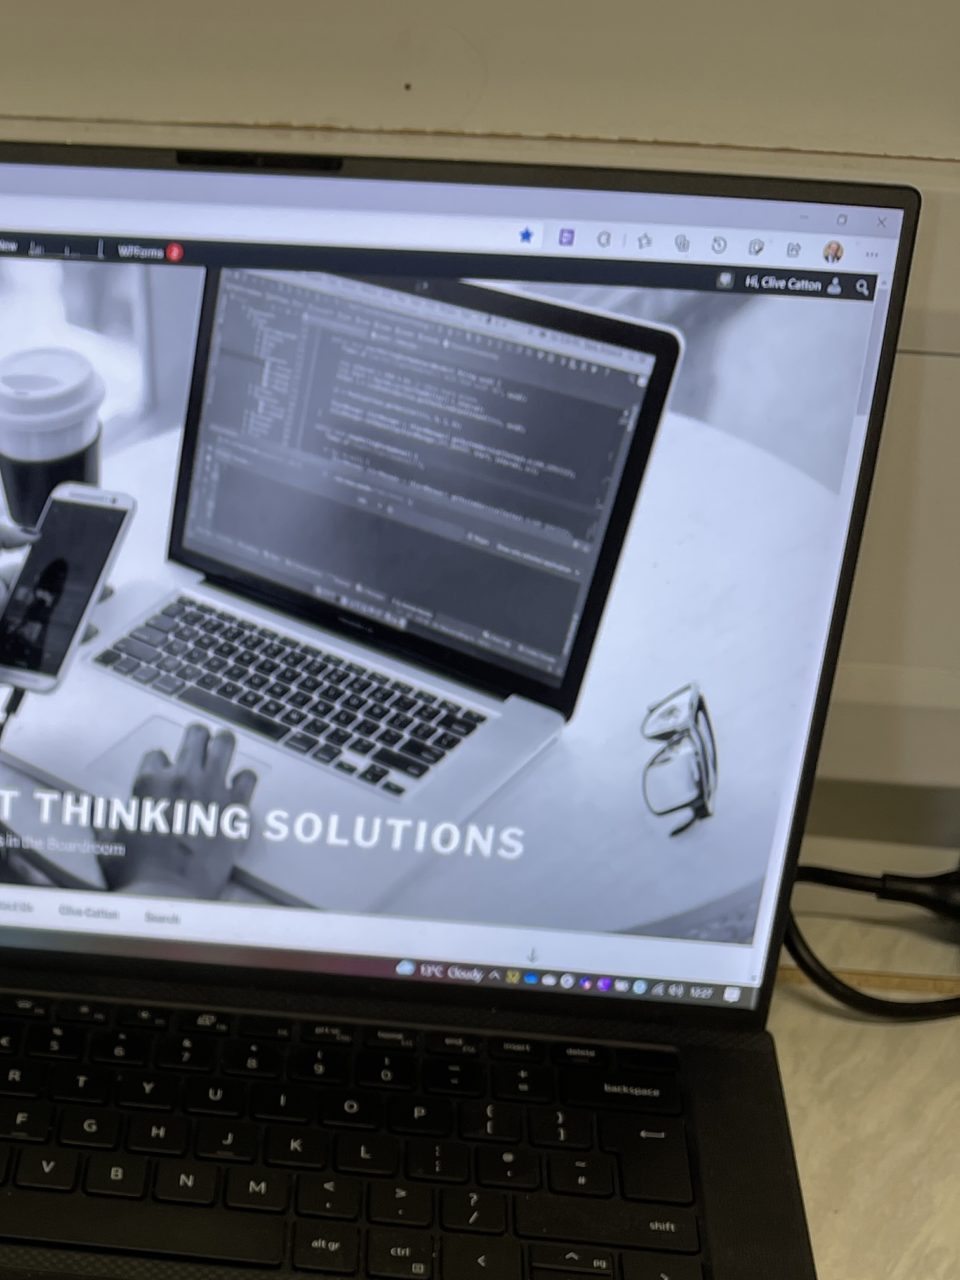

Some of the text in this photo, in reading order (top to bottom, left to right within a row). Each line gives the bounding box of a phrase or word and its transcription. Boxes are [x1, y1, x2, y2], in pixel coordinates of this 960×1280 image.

[761, 275, 787, 290] Clive
[787, 277, 822, 292] Catton
[33, 791, 250, 841] THINKING
[262, 807, 525, 860] SOLUTIONS
[5, 832, 20, 849] in
[446, 964, 486, 984] Cloudy
[7, 1069, 22, 1082] R
[76, 1075, 89, 1088] T
[142, 1081, 155, 1094] Y
[208, 1087, 223, 1101] U
[603, 1082, 660, 1098] backspace
[343, 1099, 359, 1114] O
[413, 1106, 426, 1119] P
[15, 1112, 29, 1125] F
[82, 1118, 98, 1133] G
[150, 1125, 166, 1139] H
[221, 1132, 234, 1146] J
[289, 1138, 303, 1153] K
[360, 1144, 371, 1159] L
[41, 1159, 56, 1174] V
[109, 1166, 124, 1181] B
[179, 1173, 195, 1188] N
[248, 1180, 267, 1195] M
[649, 1220, 676, 1233] shift
[311, 1238, 341, 1252] alt gr
[390, 1246, 411, 1257] ctrl
[592, 1258, 608, 1270] pg
